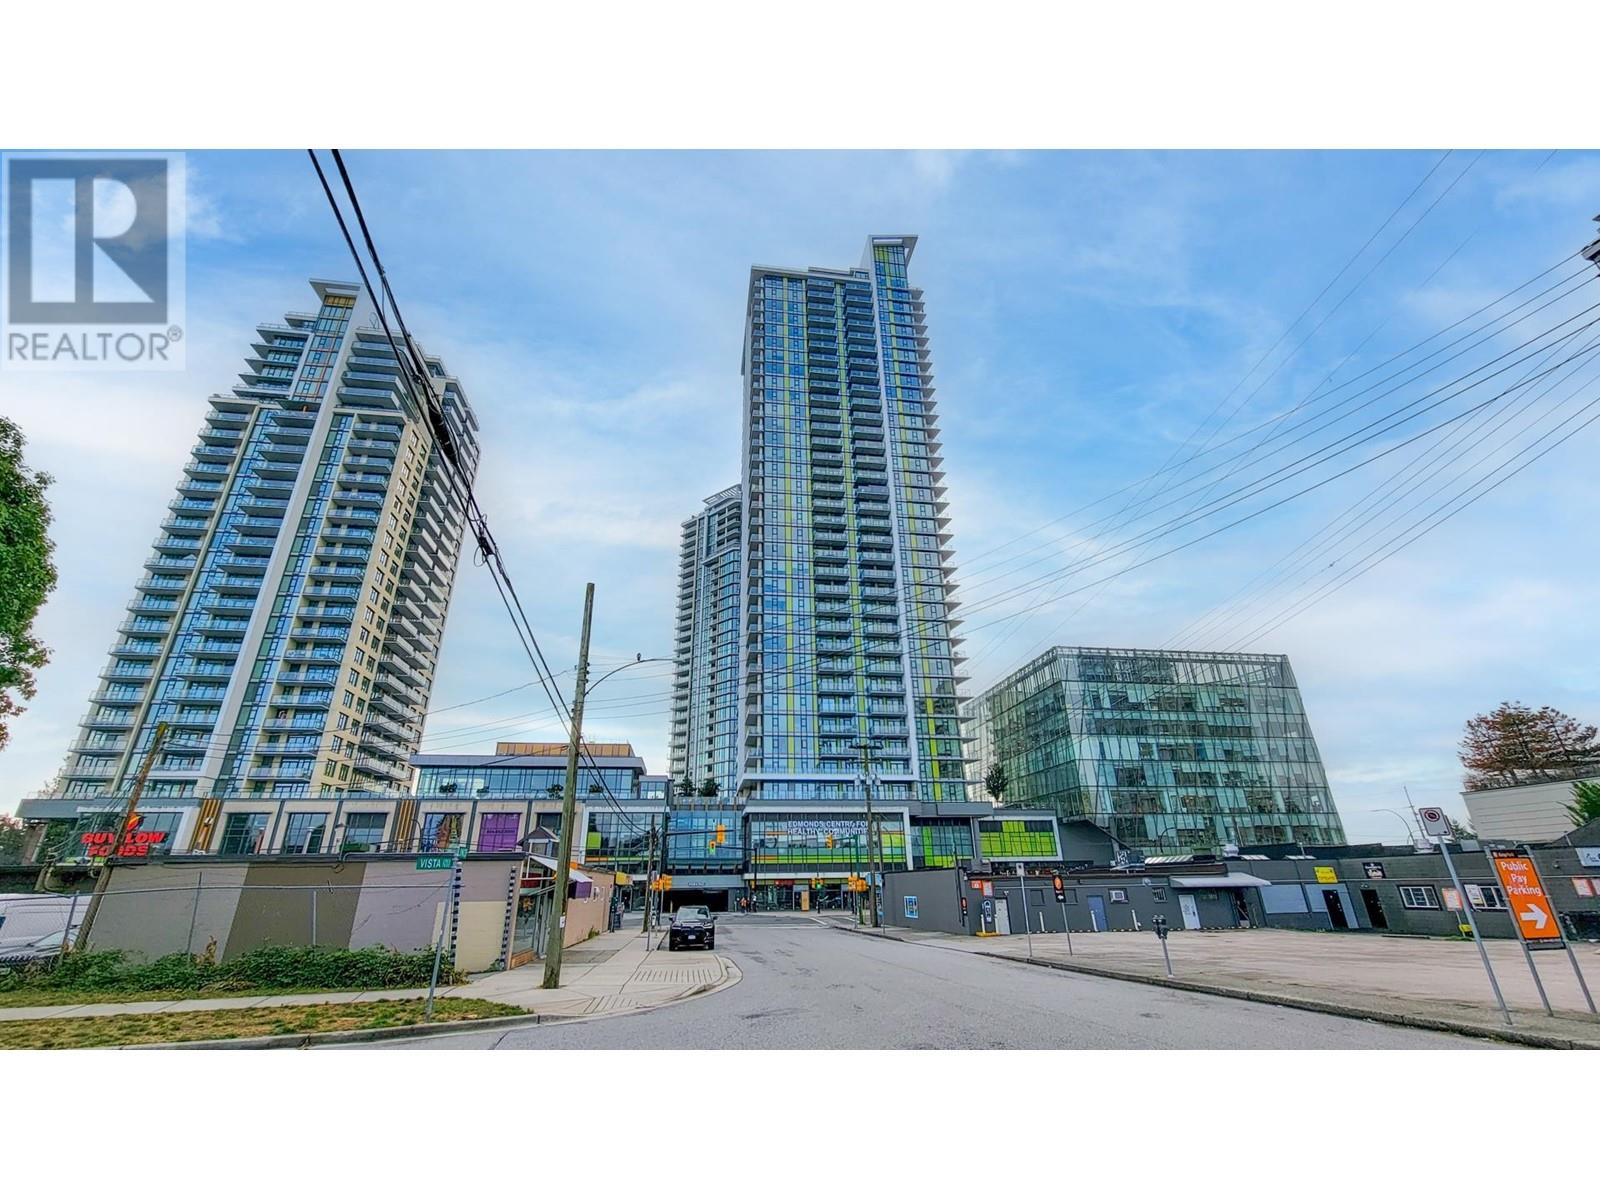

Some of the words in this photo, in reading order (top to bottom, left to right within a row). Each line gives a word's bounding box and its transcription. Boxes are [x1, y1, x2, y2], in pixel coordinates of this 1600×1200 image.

[787, 820, 824, 828] EDMONDS
[125, 831, 166, 844] LOW
[419, 858, 441, 868] VISTA
[1500, 861, 1529, 871] Public
[1510, 873, 1528, 885] Pay
[1506, 886, 1542, 897] Parking
